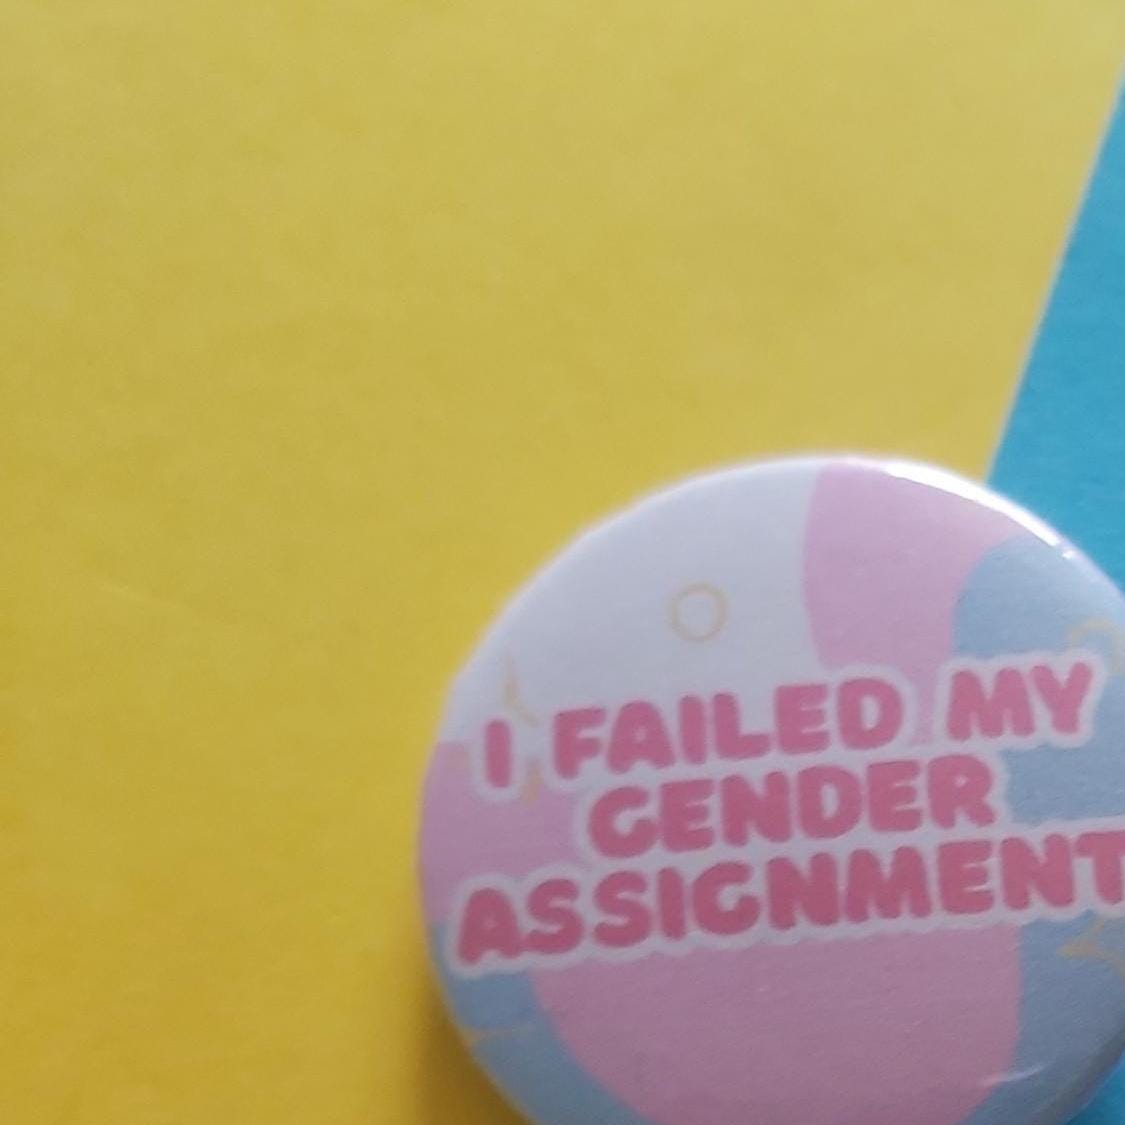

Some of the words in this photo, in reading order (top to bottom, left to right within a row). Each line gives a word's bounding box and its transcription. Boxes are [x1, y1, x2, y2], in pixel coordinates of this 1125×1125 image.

[484, 719, 512, 789] I
[552, 676, 903, 781] FAILED
[945, 662, 1094, 744] MY
[588, 753, 996, 859] GENDER
